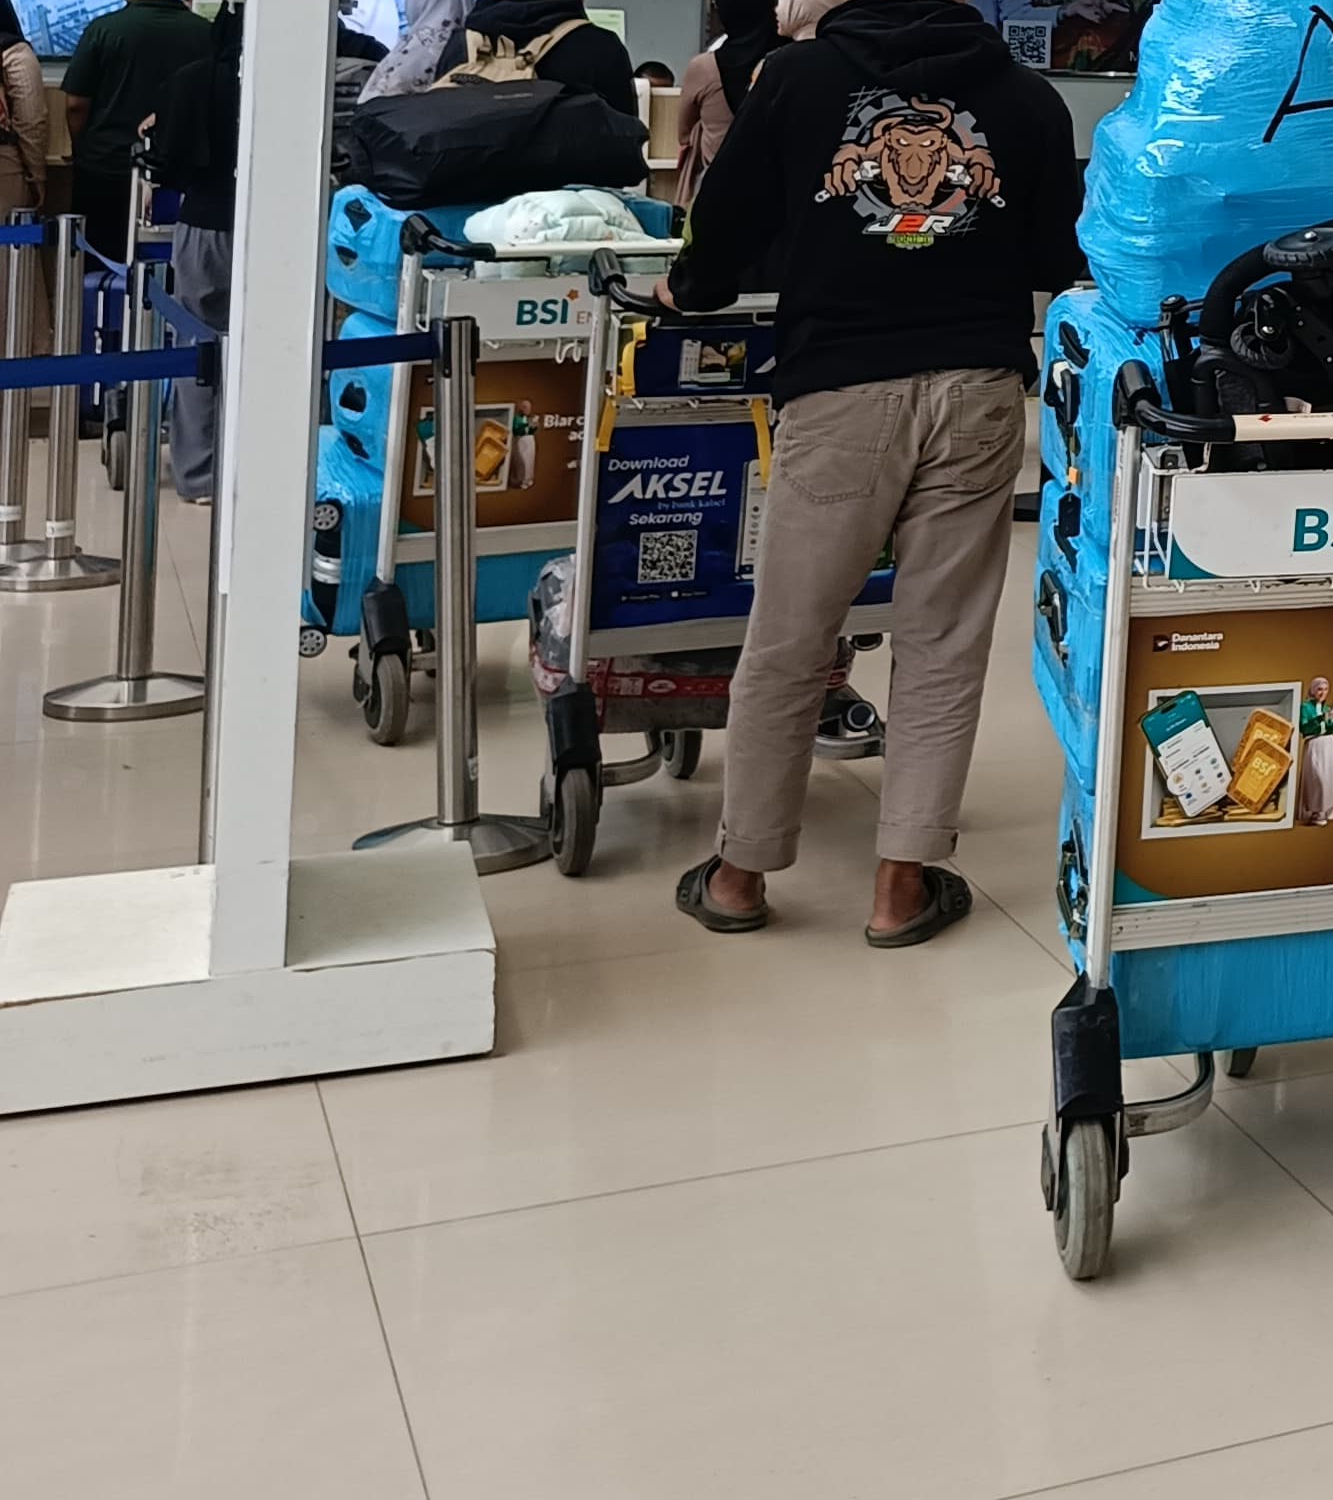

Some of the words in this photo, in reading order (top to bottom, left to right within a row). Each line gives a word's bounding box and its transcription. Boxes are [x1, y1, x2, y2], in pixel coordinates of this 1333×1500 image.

[867, 213, 955, 234] J2R
[516, 297, 569, 326] BSI
[544, 414, 575, 429] Biar
[608, 455, 690, 472] Download
[608, 470, 727, 504] AKSEL
[628, 512, 704, 526] Sekarang
[1172, 632, 1224, 642] Danantara
[1171, 640, 1220, 651] Indonesia
